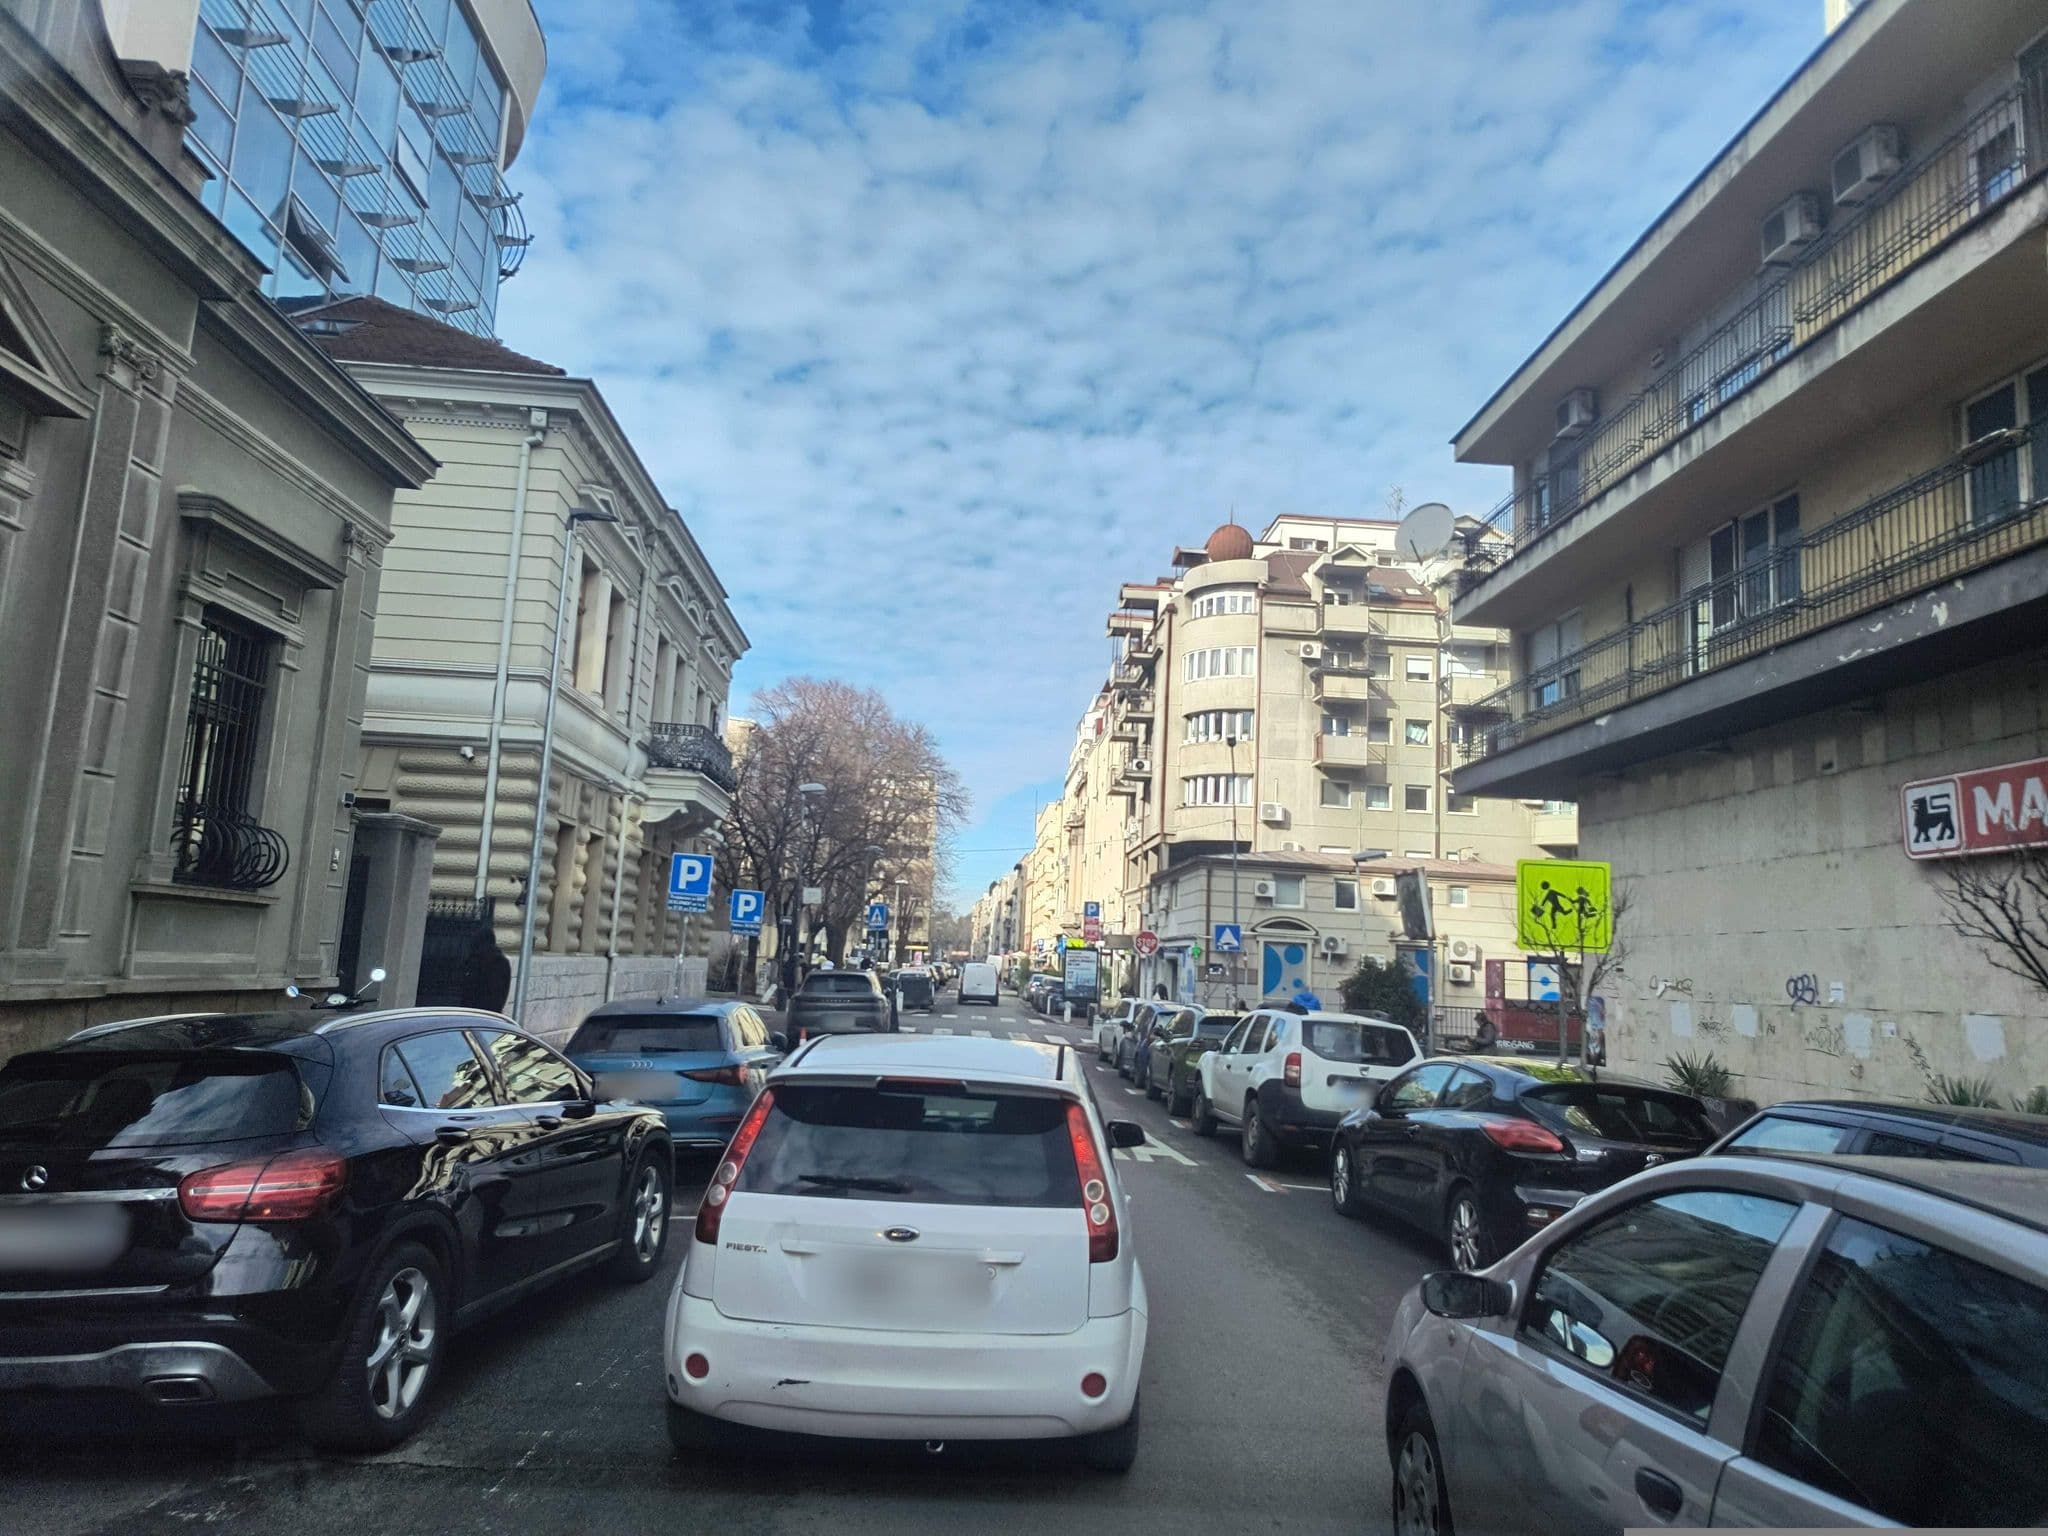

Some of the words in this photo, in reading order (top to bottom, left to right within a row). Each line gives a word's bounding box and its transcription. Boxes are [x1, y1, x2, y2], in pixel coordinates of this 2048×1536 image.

[678, 859, 703, 889] P
[737, 894, 757, 918] P
[1087, 903, 1097, 916] P
[1136, 937, 1157, 948] STOP
